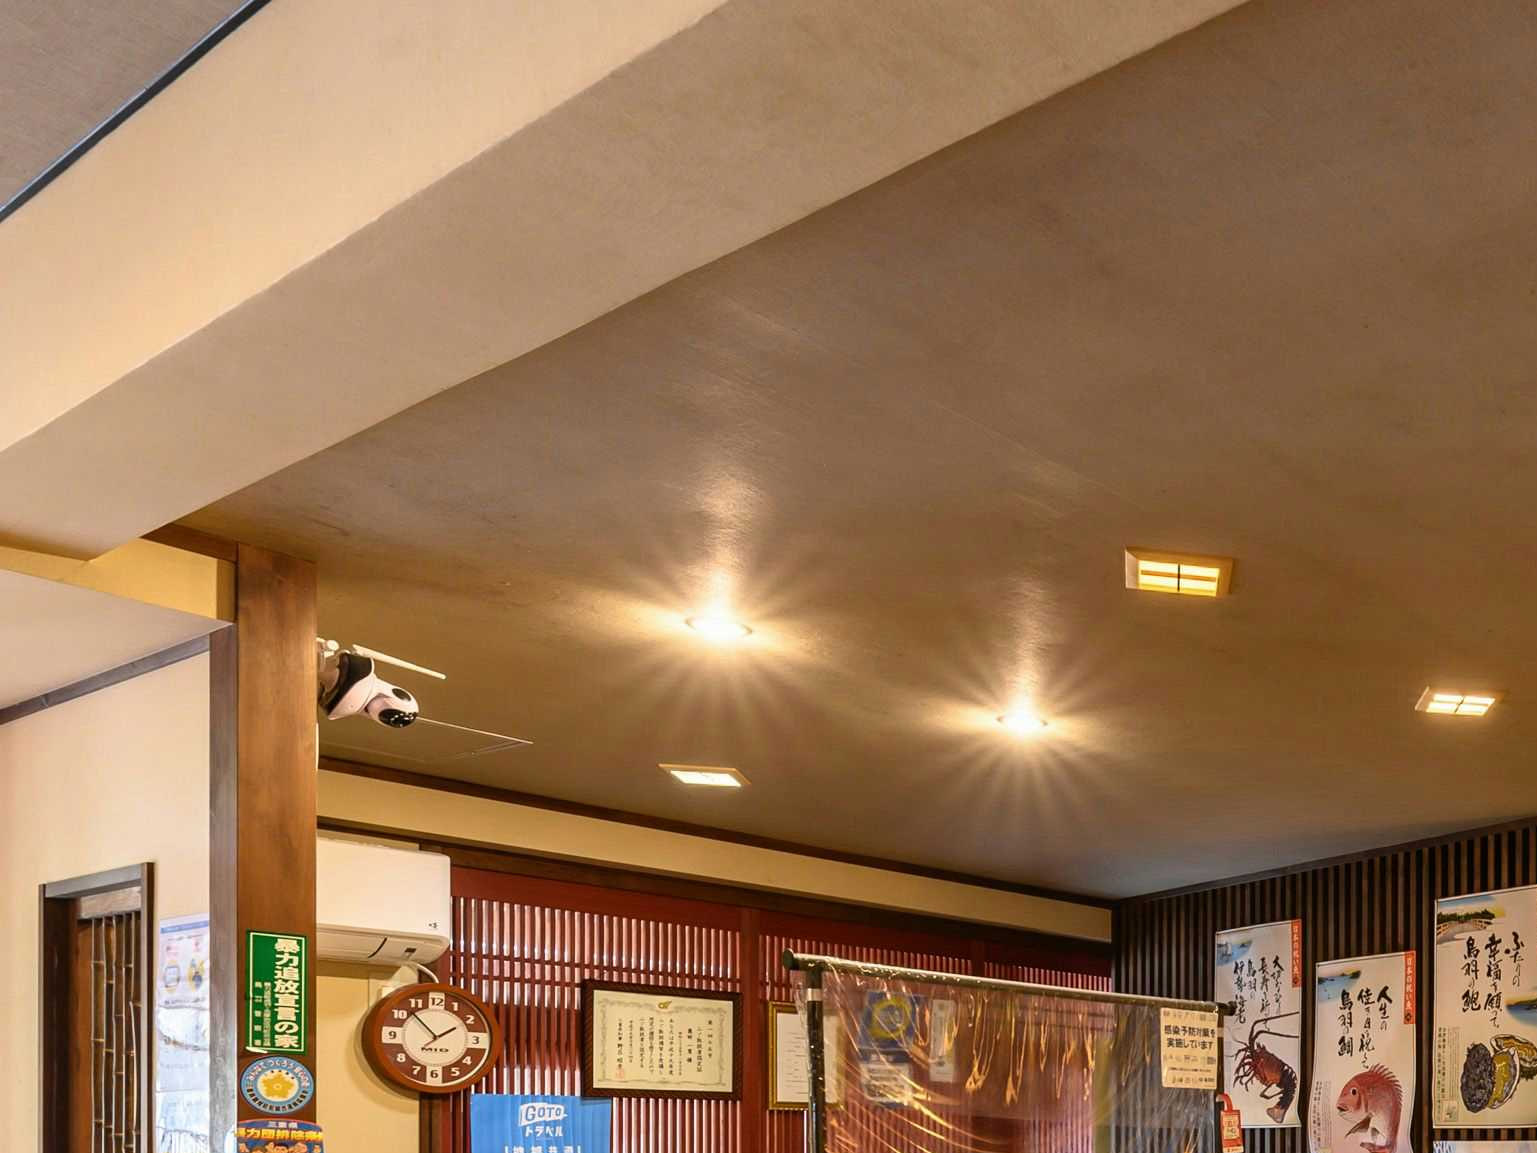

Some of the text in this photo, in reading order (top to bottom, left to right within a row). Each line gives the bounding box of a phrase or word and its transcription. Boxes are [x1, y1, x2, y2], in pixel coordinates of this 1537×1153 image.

[409, 998, 423, 1008] 11
[430, 997, 444, 1007] 12
[451, 1002, 459, 1011] 1
[392, 1009, 408, 1020] 10
[465, 1014, 475, 1025] 2
[388, 1031, 397, 1040] 9
[472, 1035, 480, 1045] 3
[396, 1053, 406, 1062] 8
[462, 1055, 472, 1065] 4
[412, 1065, 421, 1075] 7
[430, 1069, 439, 1079] 6
[451, 1066, 460, 1076] 5
[524, 1126, 563, 1137] トラベル
